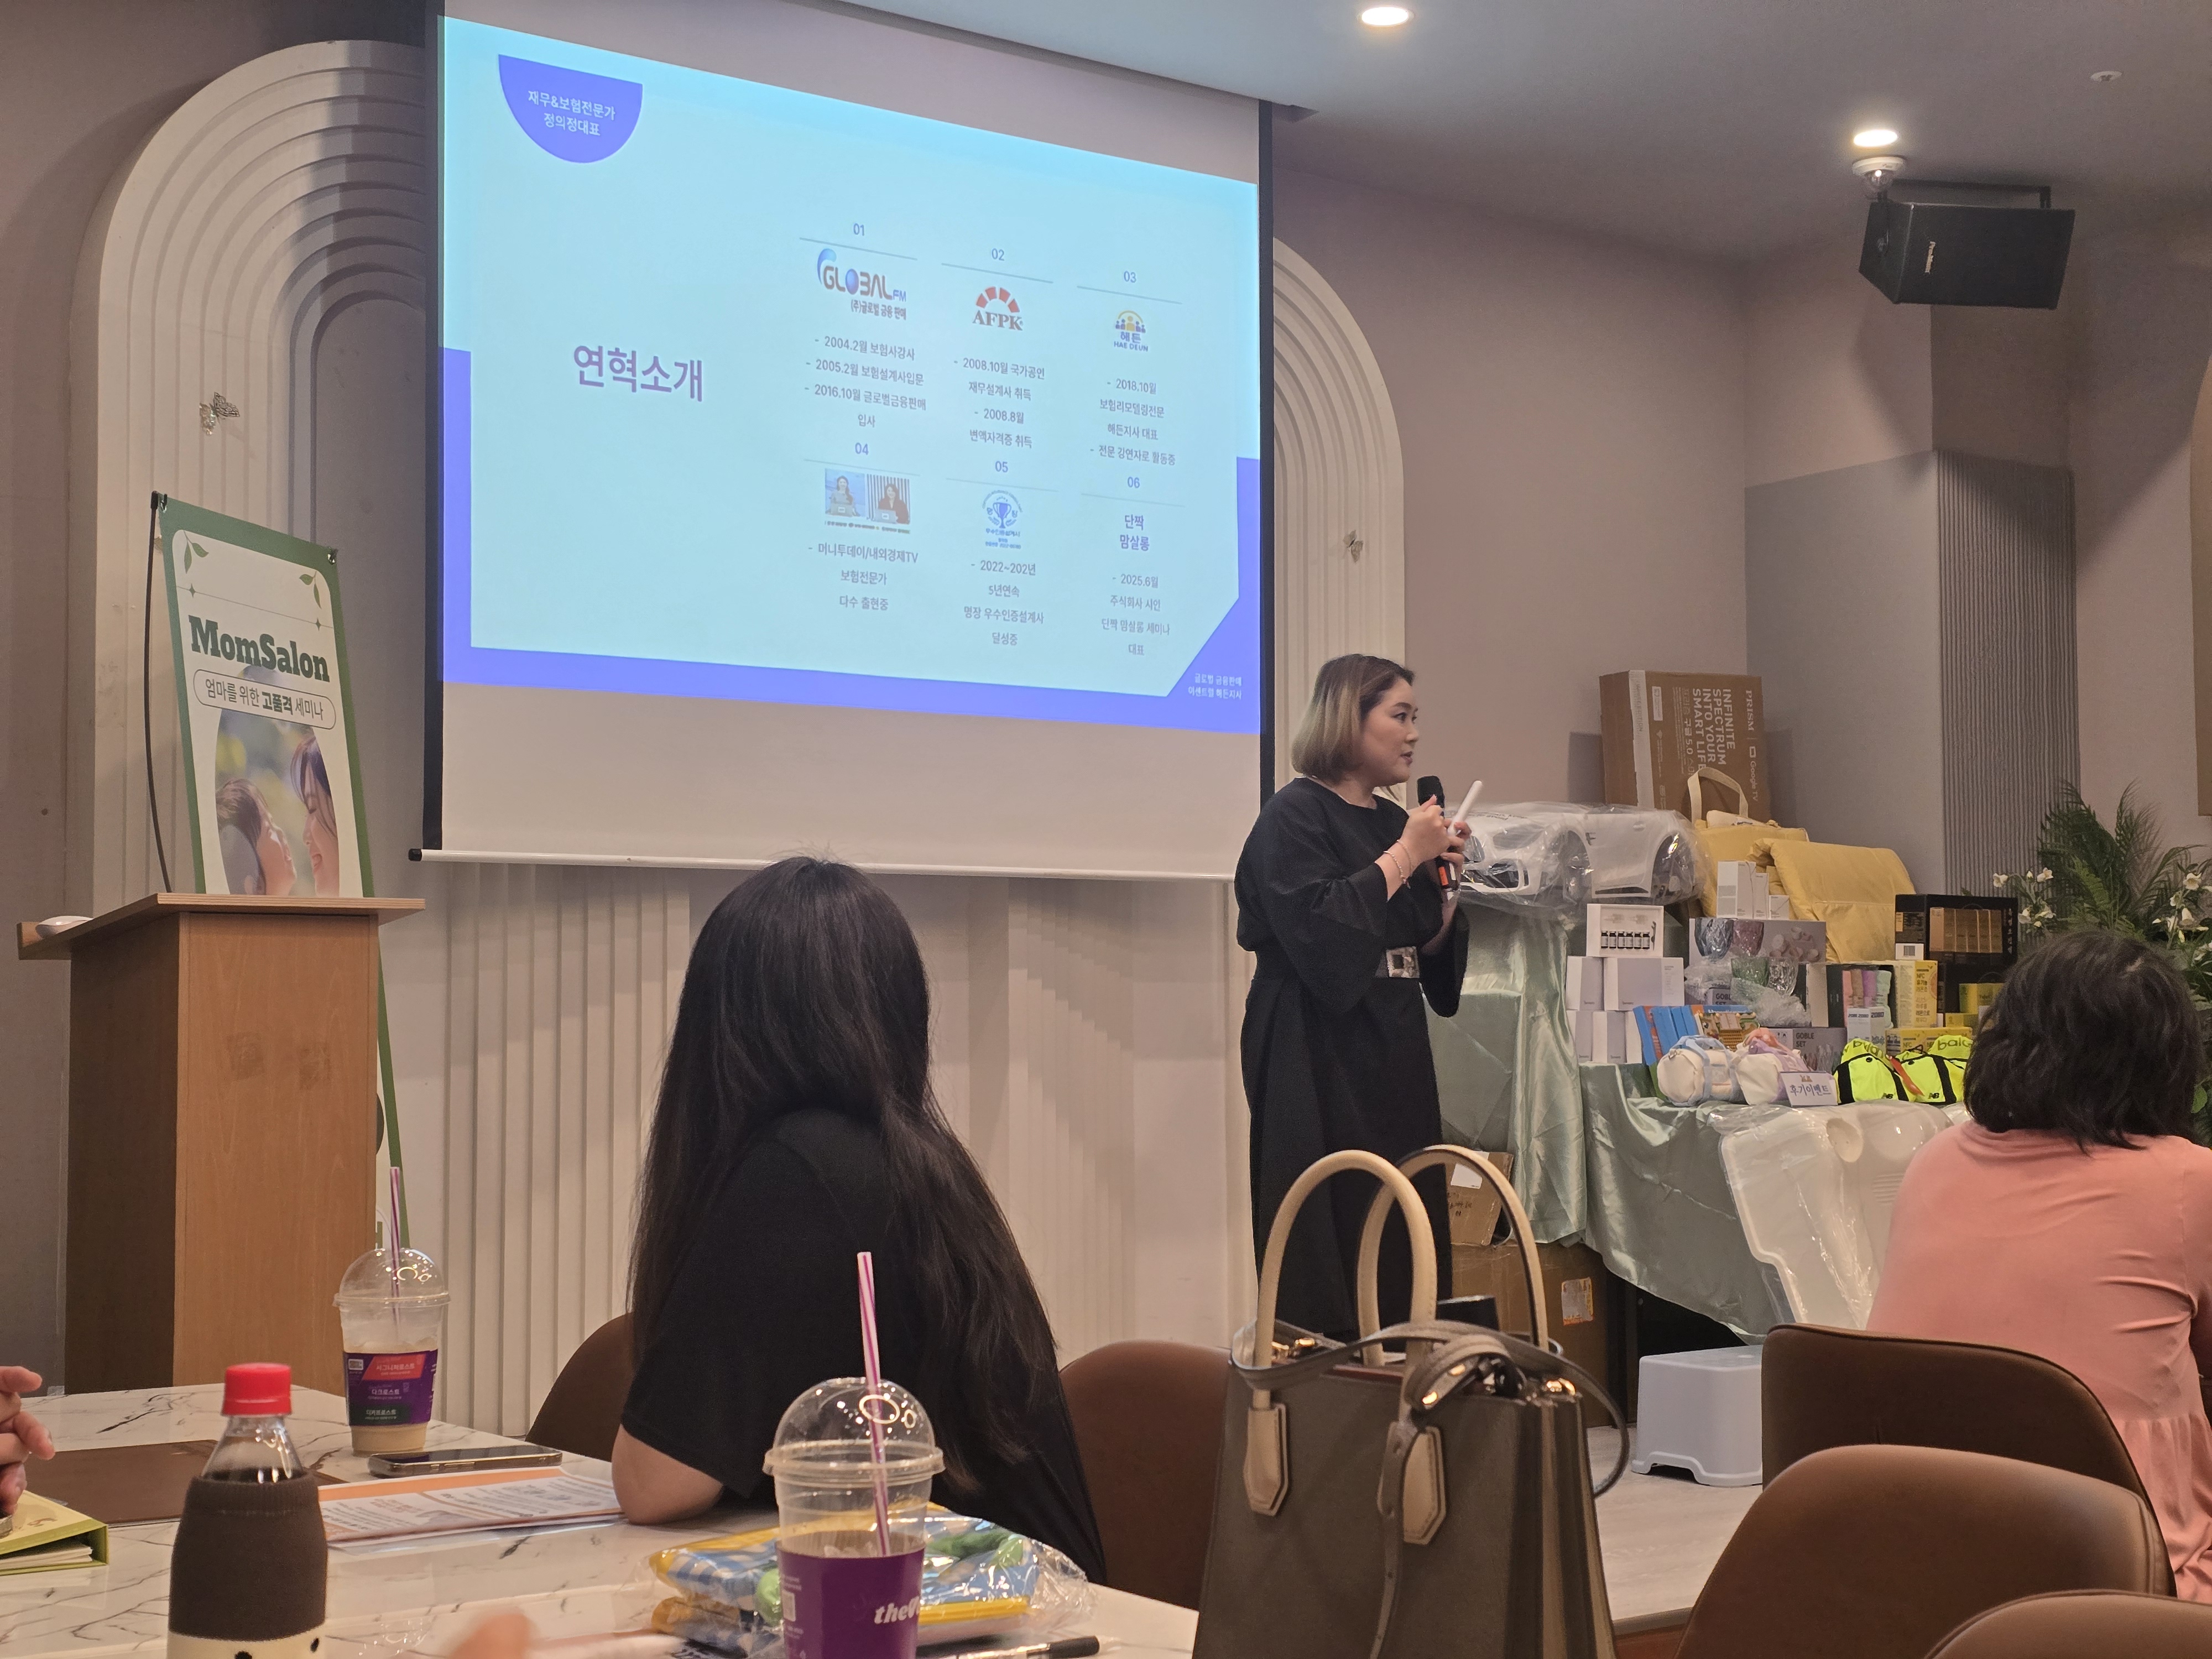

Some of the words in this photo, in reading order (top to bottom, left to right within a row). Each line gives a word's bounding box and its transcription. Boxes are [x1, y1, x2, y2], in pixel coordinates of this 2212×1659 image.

[528, 90, 615, 121] 재무&보험전문가
[544, 112, 601, 136] 정의정대표
[853, 223, 865, 236] 01
[992, 248, 1005, 261] 02
[1124, 270, 1137, 283] 03
[972, 310, 1023, 331] AFPK
[825, 336, 868, 353] 2004.2월
[870, 342, 915, 361] 보험사강사
[1114, 341, 1128, 349] HAE
[1129, 342, 1149, 352] DEUN
[573, 345, 702, 402] 연혁소개
[816, 359, 859, 377] 2005.2월
[862, 365, 924, 386] 보험설계사입문
[963, 358, 1008, 374] 2008.10월
[1011, 363, 1045, 380] 국가공인
[969, 381, 1012, 398] 재무설계사
[1014, 388, 1031, 401] 취득
[1116, 378, 1157, 395] 2018.10월
[815, 384, 860, 402] 2016.10월
[863, 390, 926, 411] 글로벌금융판매
[984, 408, 1024, 424] 2008.8월
[1100, 399, 1165, 419] 보험리모델링전문
[858, 414, 875, 428] 입사
[969, 429, 1013, 447] 변액자격증
[1015, 435, 1032, 448] 취득
[1108, 423, 1140, 439] 해든지사
[1142, 427, 1159, 441] 대표
[855, 442, 869, 455] 04
[1099, 444, 1115, 458] 전문
[995, 461, 1009, 473] 05
[1127, 476, 1140, 488] 06
[1124, 514, 1144, 530] 단짝
[1120, 534, 1150, 551] 맘살롱
[980, 560, 1036, 576] 2022~202년
[841, 569, 888, 586] 보험전문가
[1120, 573, 1159, 588] 2025.6월
[989, 585, 1020, 598] 5년연속
[839, 594, 859, 609] 다수
[1110, 595, 1143, 610] 주식회사
[984, 608, 1044, 624] 우수인증설계사
[1146, 622, 1170, 636] 세미나
[188, 614, 330, 683] MomSalon
[1128, 643, 1145, 656] 대표
[205, 678, 237, 703] 엄마를
[239, 686, 260, 708] 위한
[262, 691, 294, 716] 고품격
[295, 697, 324, 721] 세미나
[1702, 688, 1713, 721] INTO
[1692, 688, 1704, 737] SMART
[1723, 688, 1736, 750] INFINITE
[1746, 690, 1755, 731] PRISM
[1684, 718, 1692, 737] 구글
[1713, 688, 1726, 765] SPECTRUM
[1705, 724, 1716, 763] YOUR
[1696, 741, 1707, 770] LIFE
[1751, 790, 1759, 802] TV
[874, 1595, 920, 1624] theV
